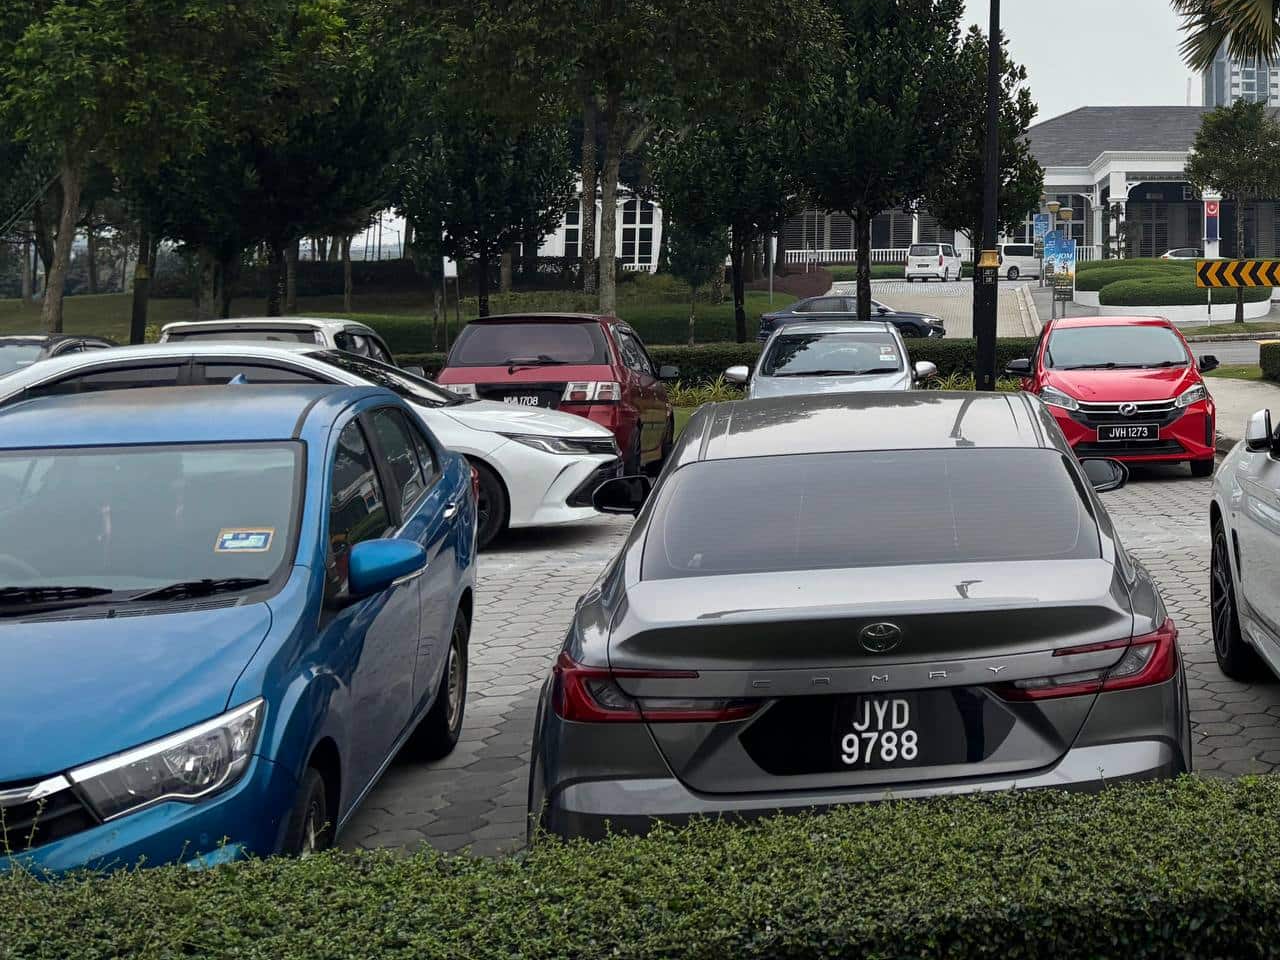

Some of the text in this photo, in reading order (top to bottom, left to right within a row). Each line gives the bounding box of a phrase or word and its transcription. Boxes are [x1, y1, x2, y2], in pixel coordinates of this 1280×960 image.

[520, 396, 539, 406] 1708
[1109, 426, 1149, 438] JVH 1273
[853, 699, 910, 732] JYD
[841, 730, 918, 764] 9788
